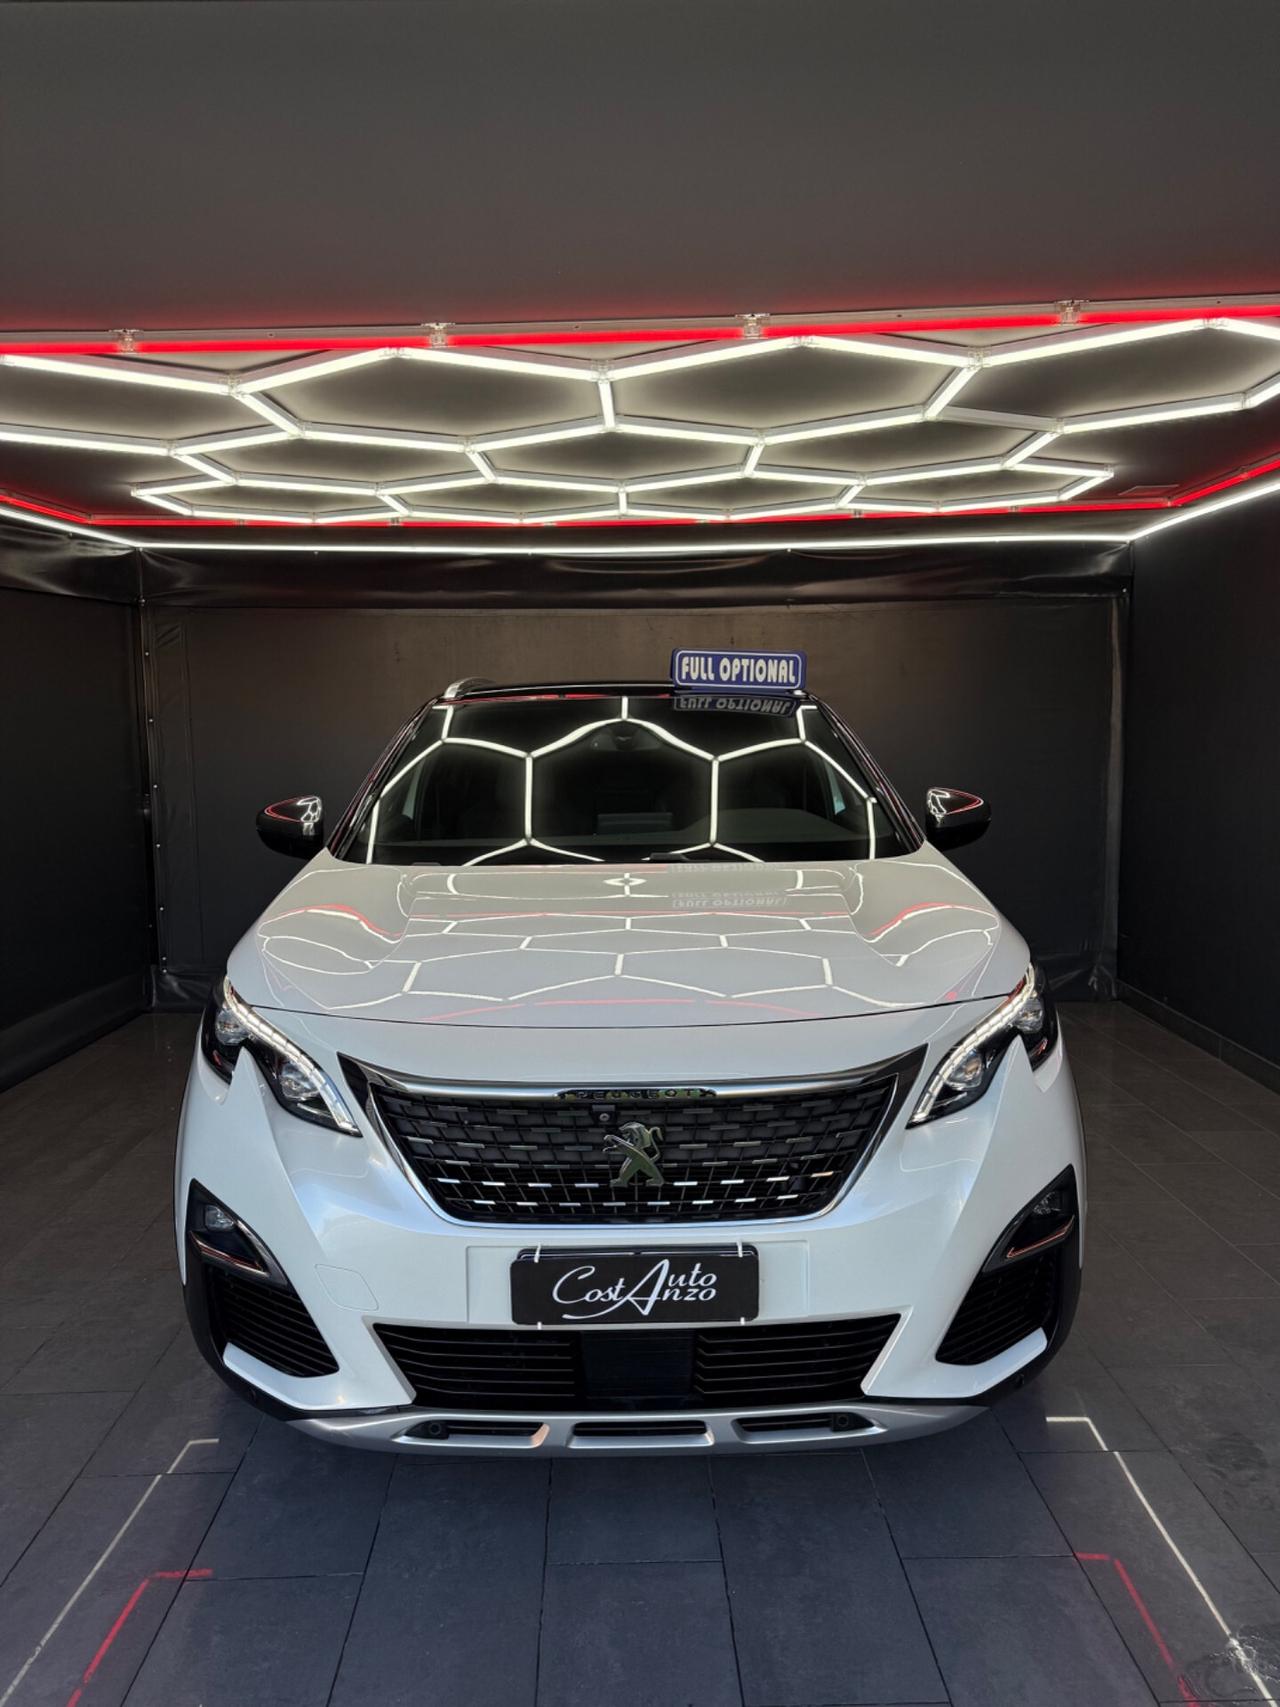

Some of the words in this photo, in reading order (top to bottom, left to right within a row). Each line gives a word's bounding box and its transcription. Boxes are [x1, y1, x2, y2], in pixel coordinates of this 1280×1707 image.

[681, 656, 715, 681] FULL
[719, 657, 796, 684] OPTIONAL
[577, 1088, 694, 1099] PEUGEOT
[552, 1265, 626, 1305] Cost
